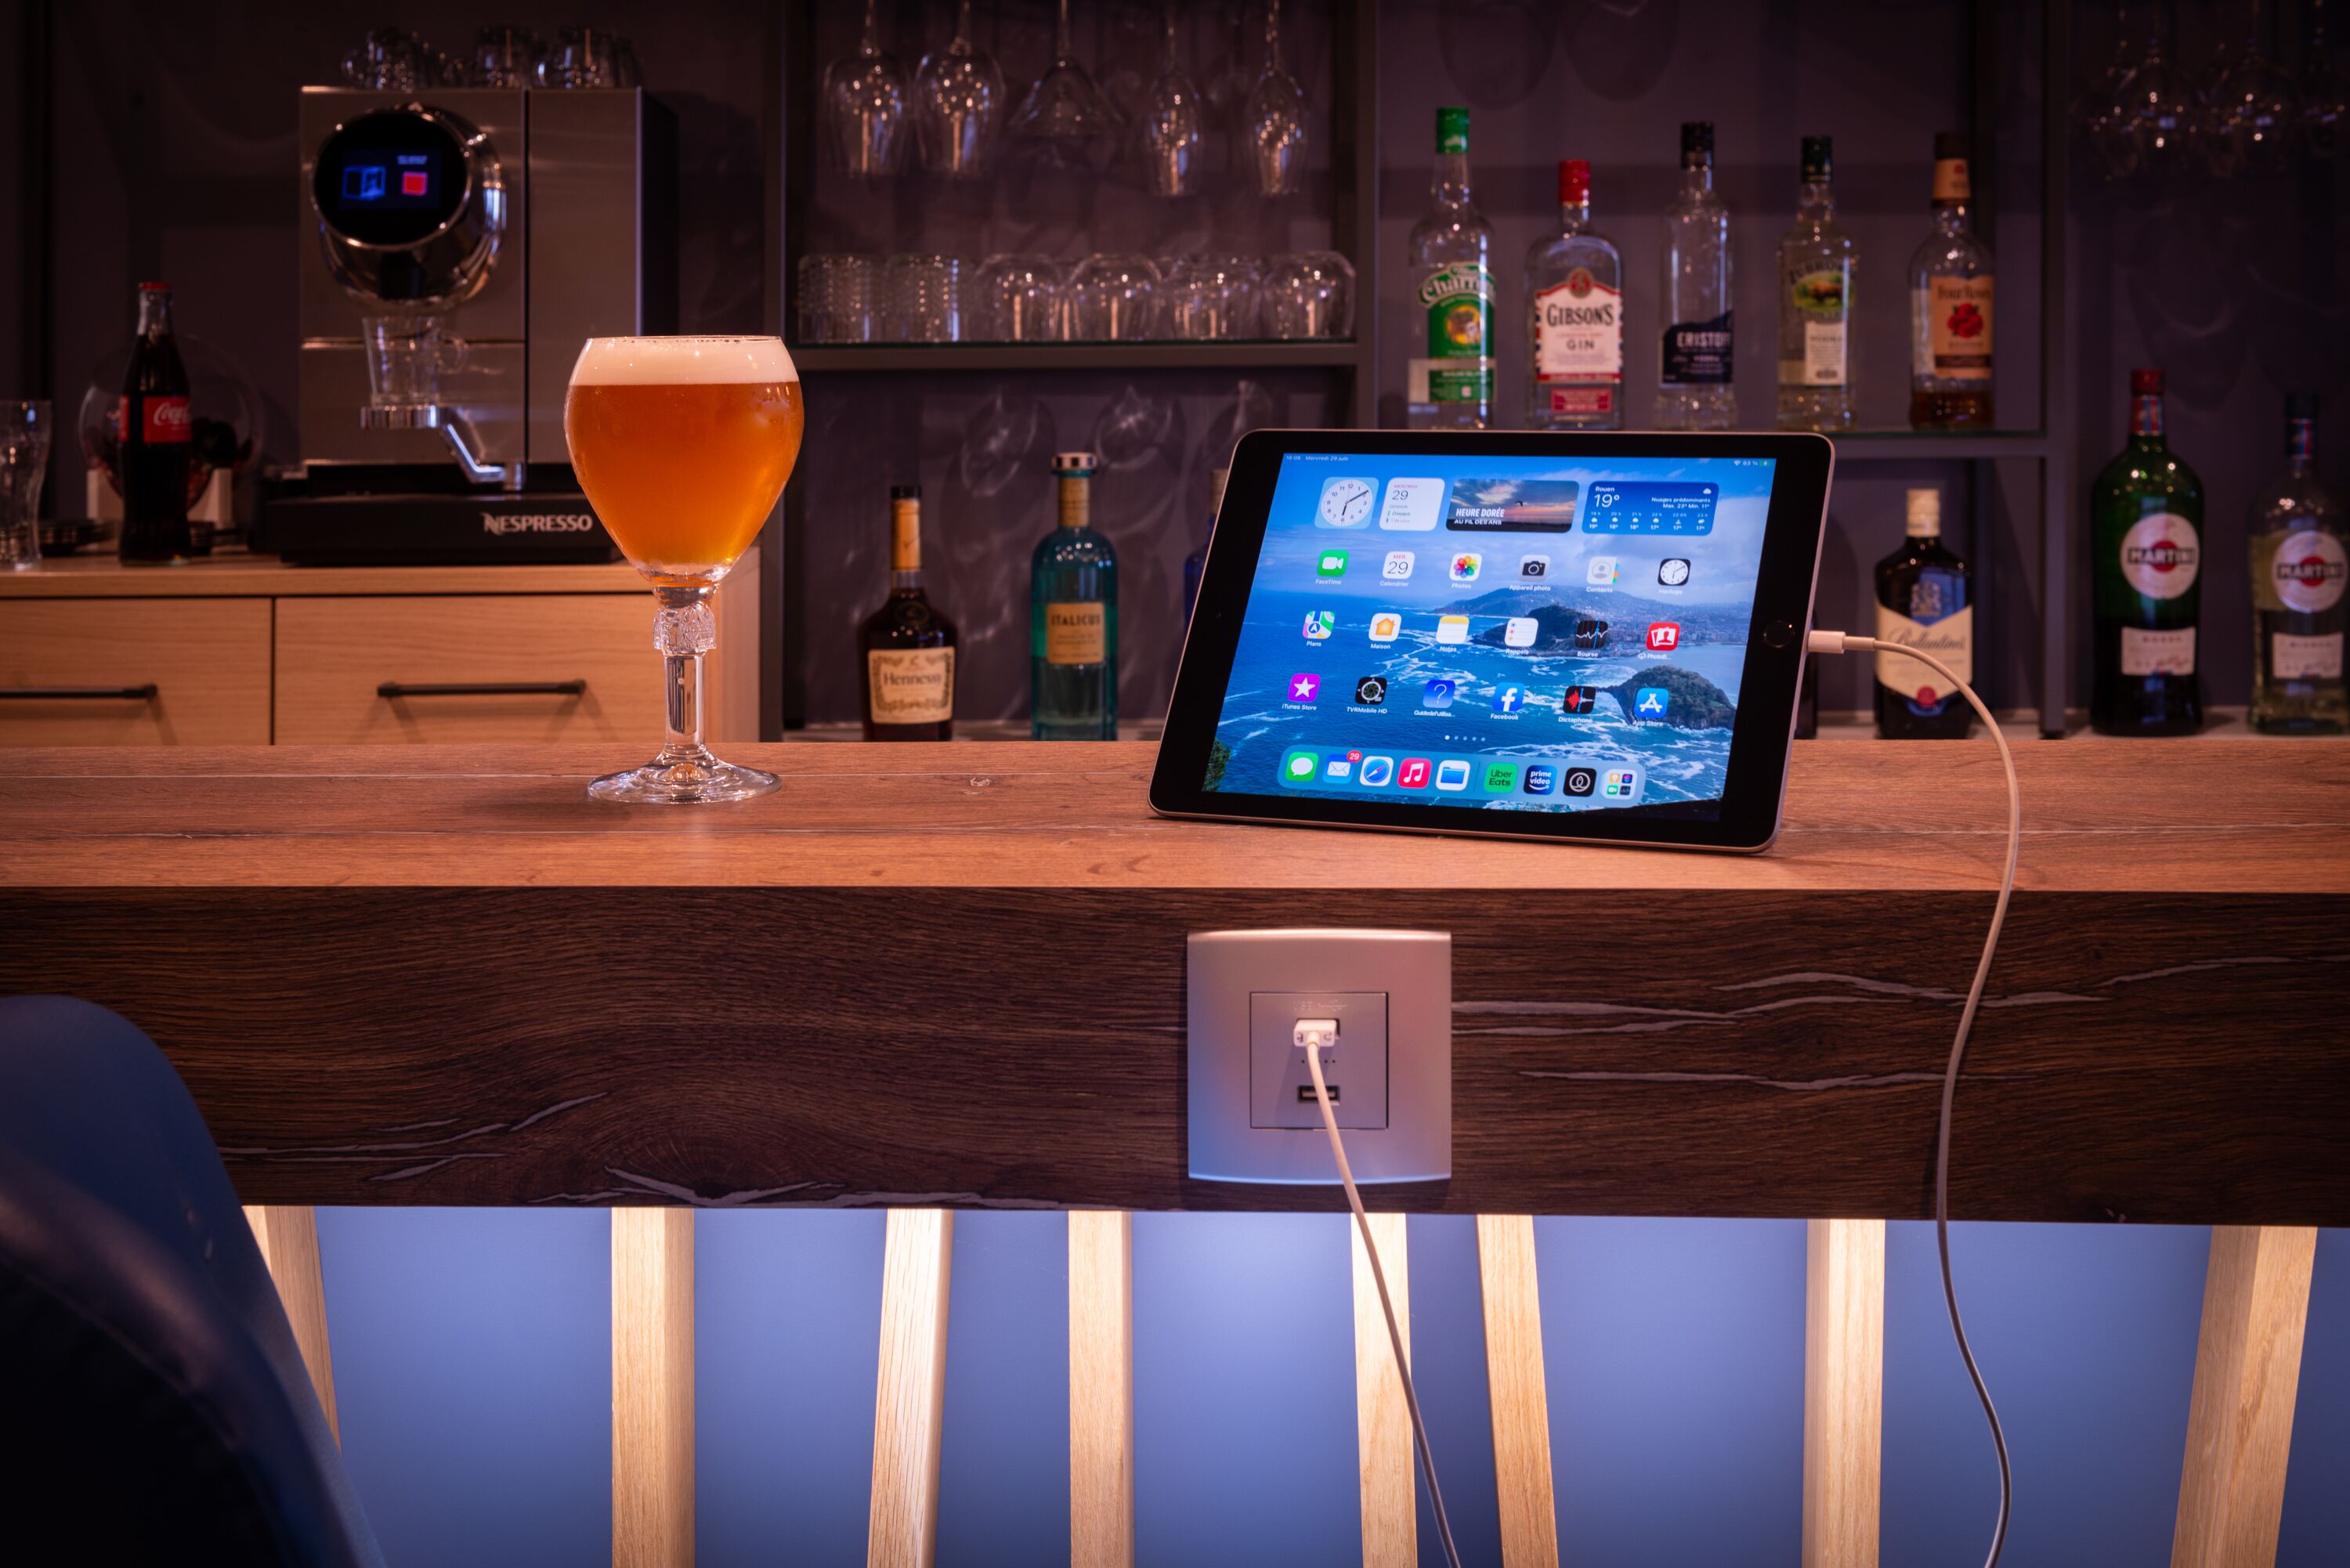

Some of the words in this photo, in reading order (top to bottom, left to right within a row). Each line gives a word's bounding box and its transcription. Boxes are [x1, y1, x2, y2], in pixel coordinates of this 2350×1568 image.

[1547, 304, 1614, 326] GIBSON'S
[1567, 340, 1594, 350] GIN
[1392, 490, 1408, 500] 29
[1594, 494, 1620, 508] 19°
[1455, 508, 1480, 517] HEURE
[1481, 508, 1505, 517] DORÉE
[480, 511, 593, 536] NESPRESSO
[2130, 549, 2193, 563] MARTINI
[1387, 561, 1408, 574] 29
[2279, 564, 2343, 578] MARTINI
[1051, 614, 1101, 626] ITALICUS
[1491, 769, 1513, 778] Uber
[1530, 771, 1552, 779] prime
[1489, 778, 1511, 786] Eats
